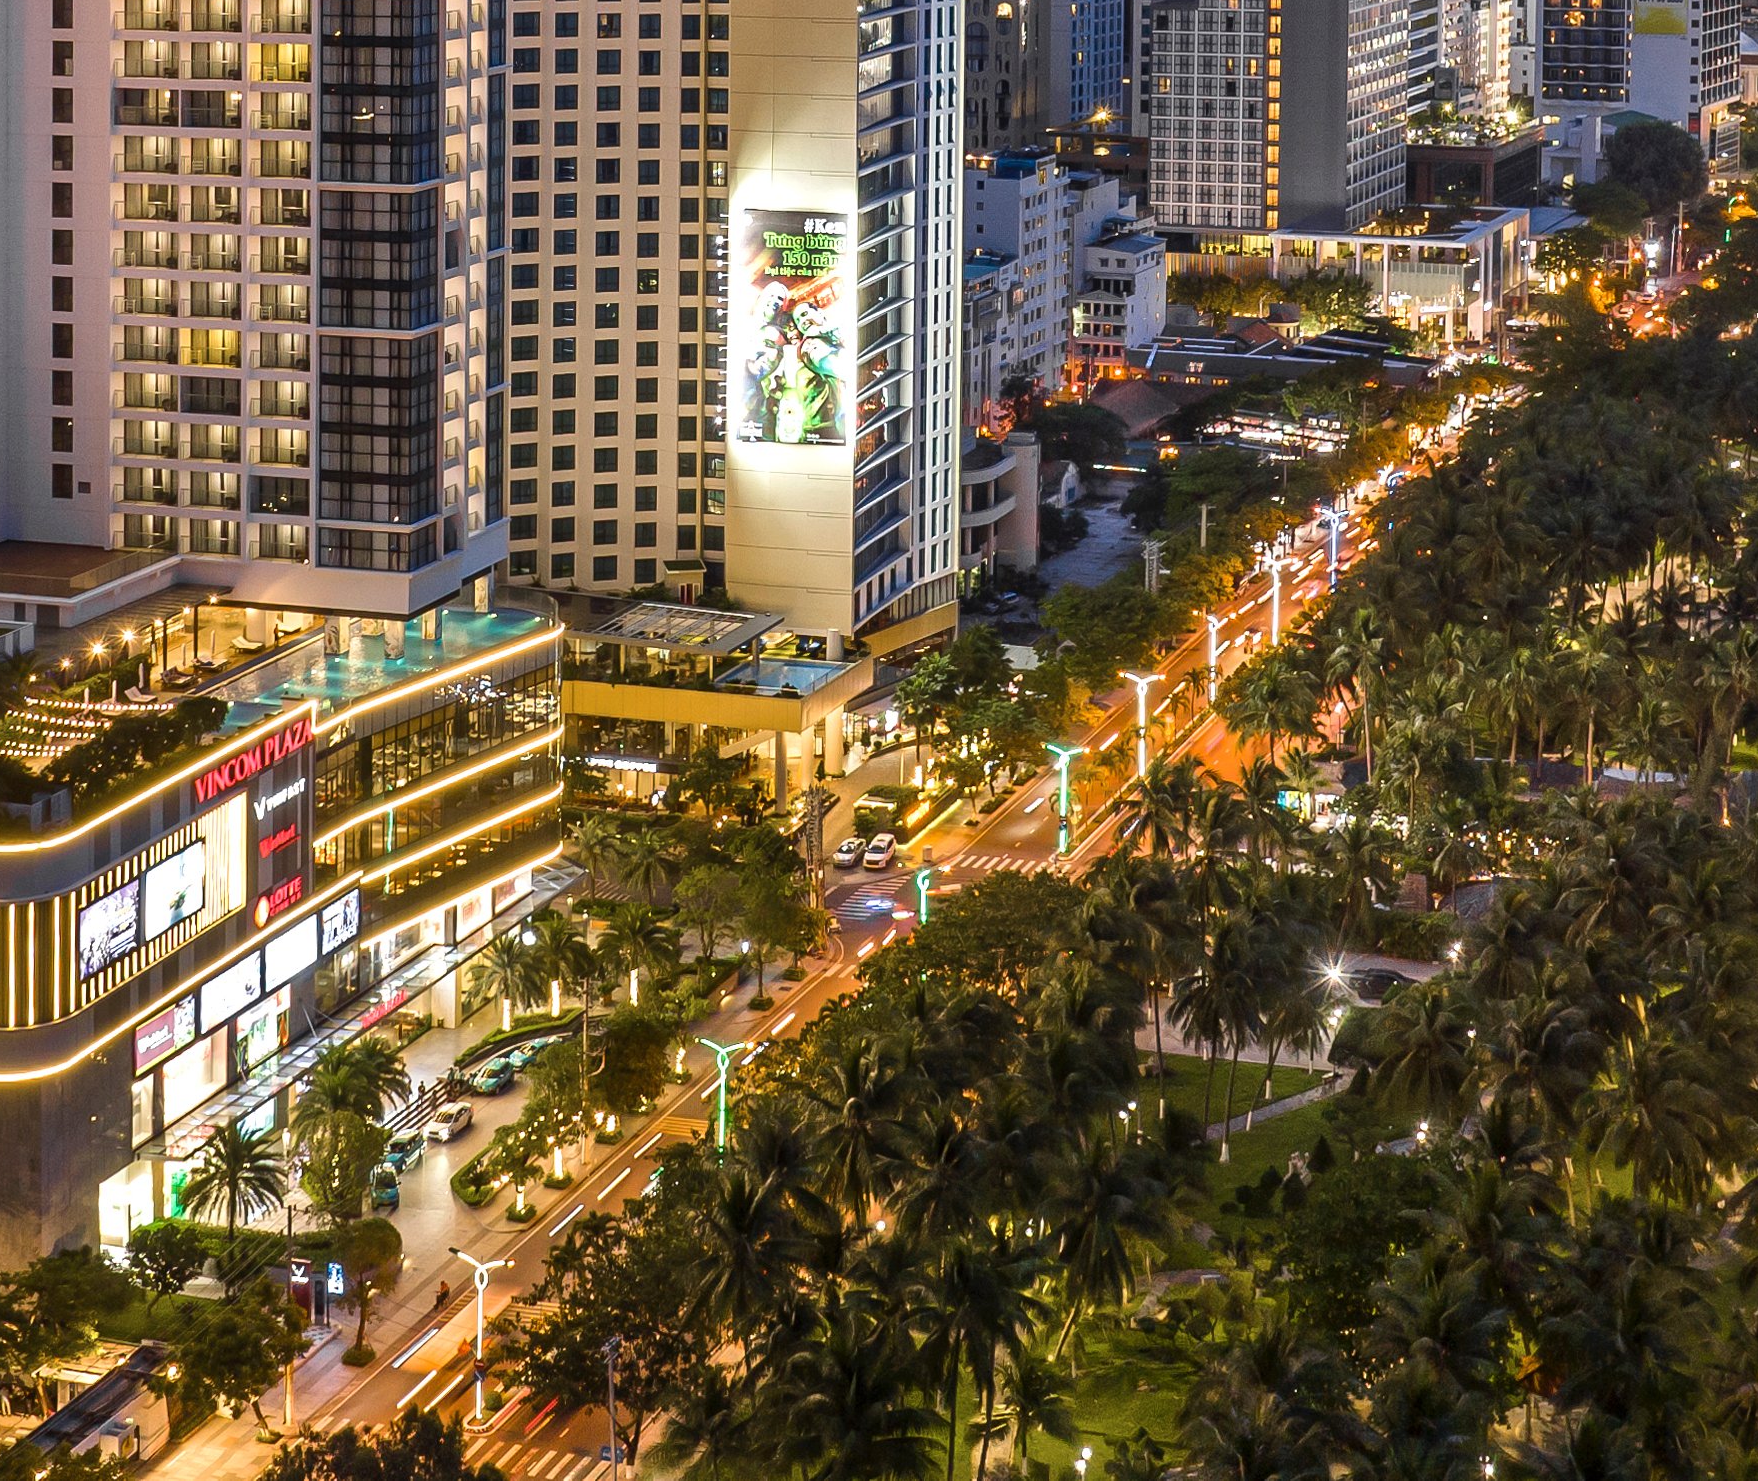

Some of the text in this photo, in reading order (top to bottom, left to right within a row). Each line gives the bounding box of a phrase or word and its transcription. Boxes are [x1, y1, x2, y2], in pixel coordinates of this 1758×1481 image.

[783, 250, 810, 266] 150
[195, 718, 314, 803] VINCOM PLAZA
[269, 876, 302, 909] LOTTE
